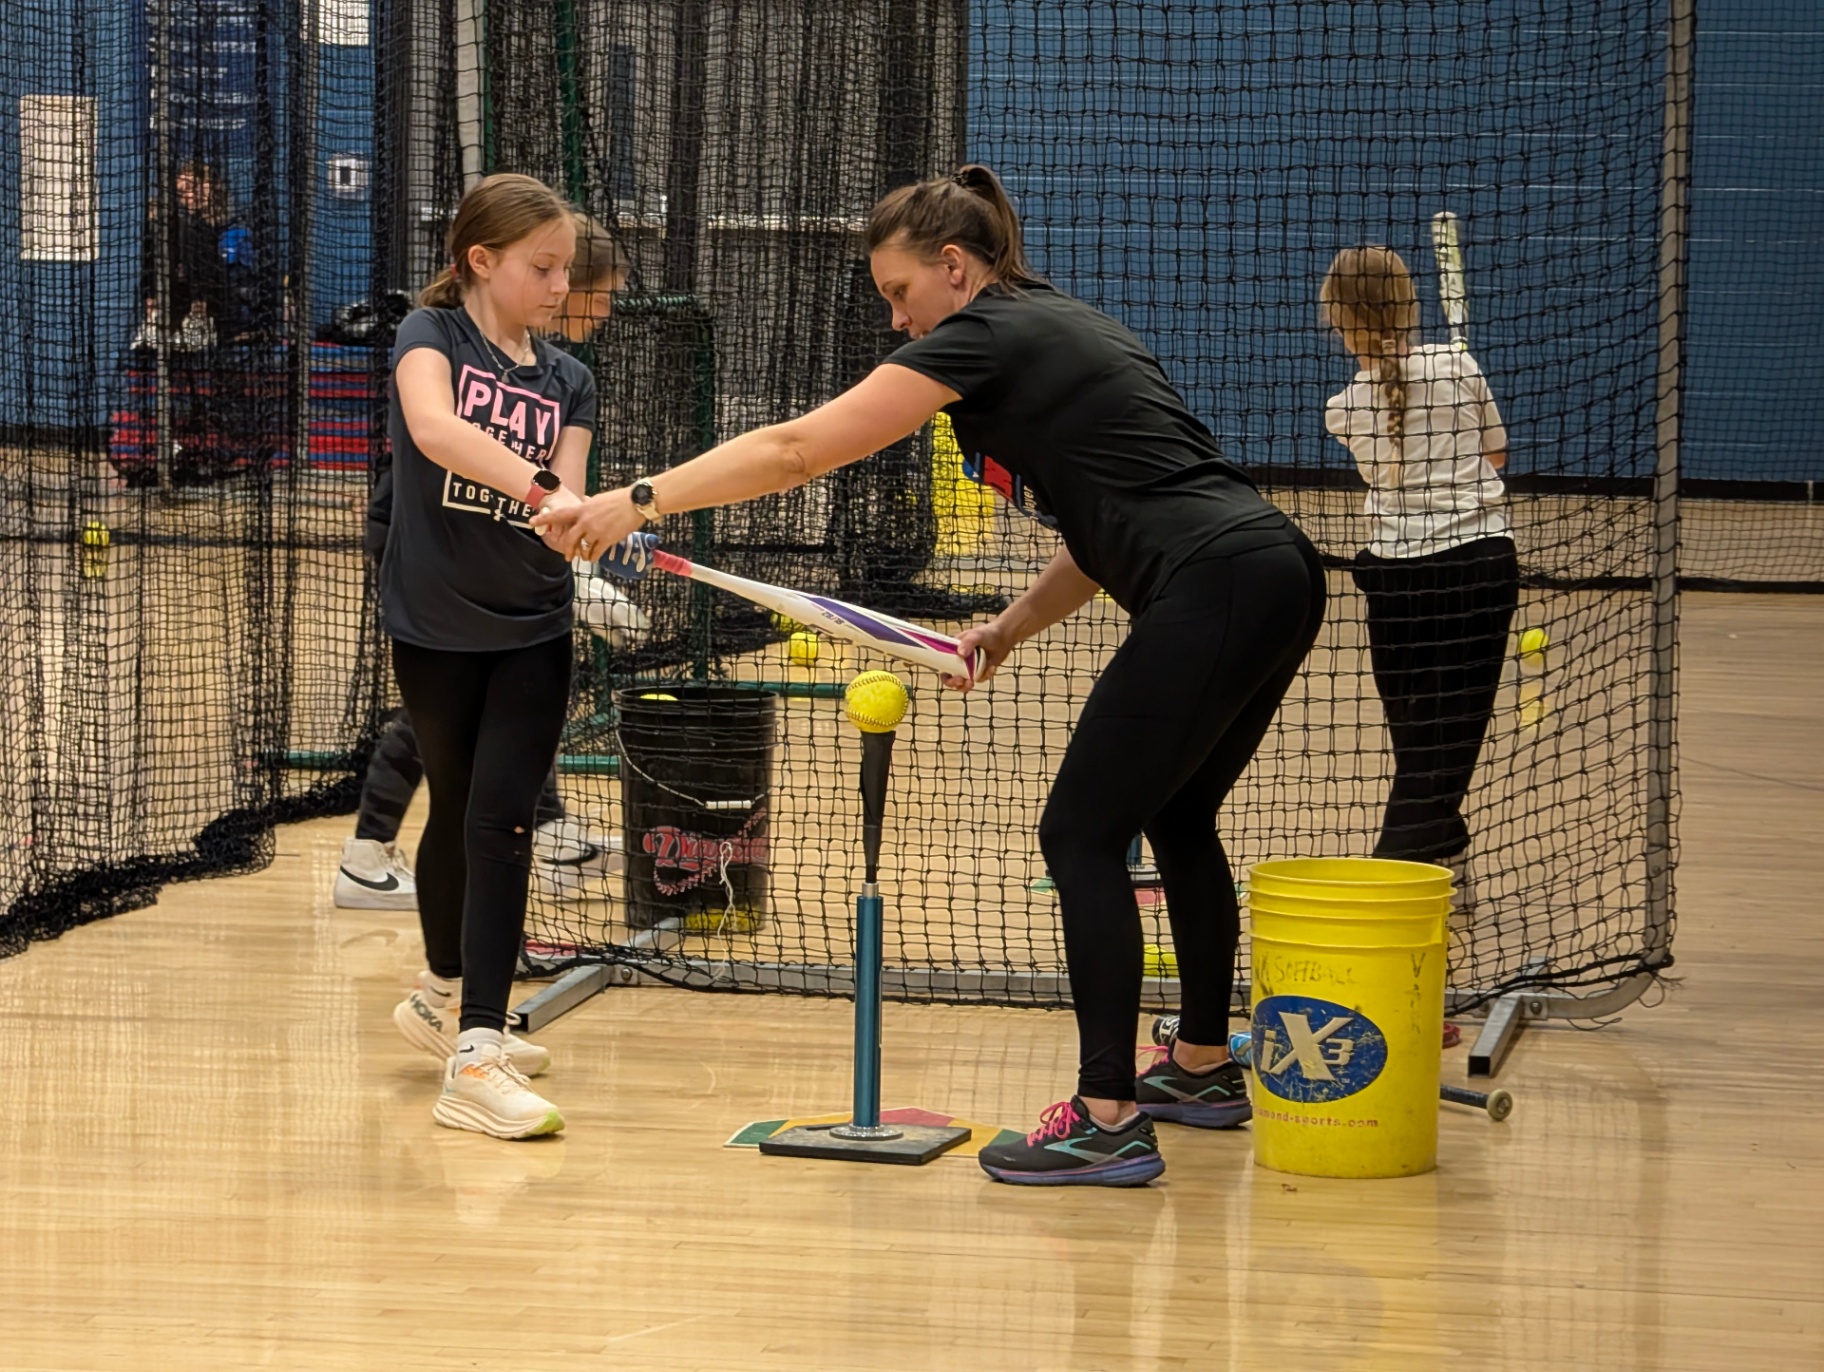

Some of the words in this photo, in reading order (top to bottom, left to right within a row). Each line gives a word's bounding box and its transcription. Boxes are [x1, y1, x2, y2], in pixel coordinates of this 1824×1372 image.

[463, 379, 552, 446] PLAY
[452, 481, 536, 519] TOGTHE
[410, 993, 444, 1033] HOKA
